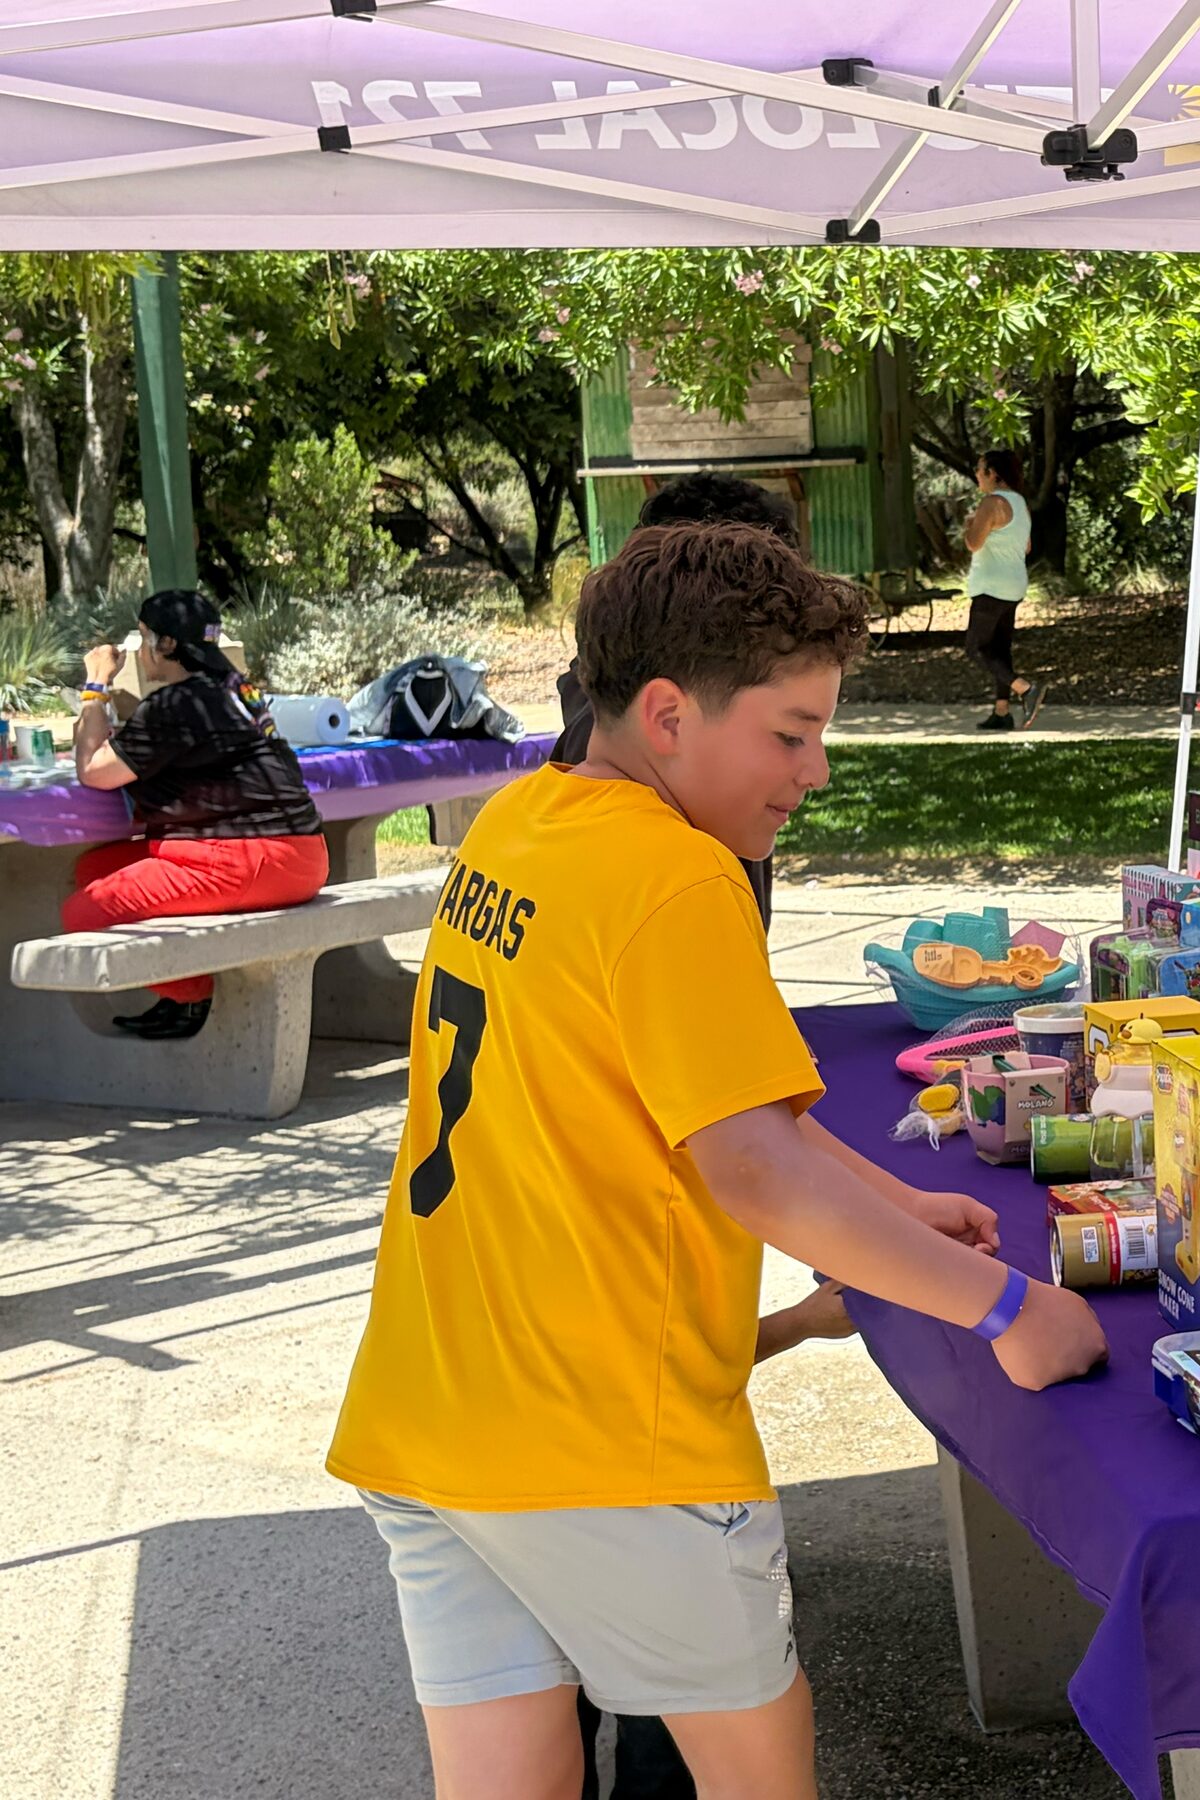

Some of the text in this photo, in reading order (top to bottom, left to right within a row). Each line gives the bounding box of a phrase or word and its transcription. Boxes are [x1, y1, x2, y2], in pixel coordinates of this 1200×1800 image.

[410, 965, 487, 1218] 7
[1158, 1269, 1196, 1315] SNOW CONE
[1159, 1287, 1180, 1321] MAKER
